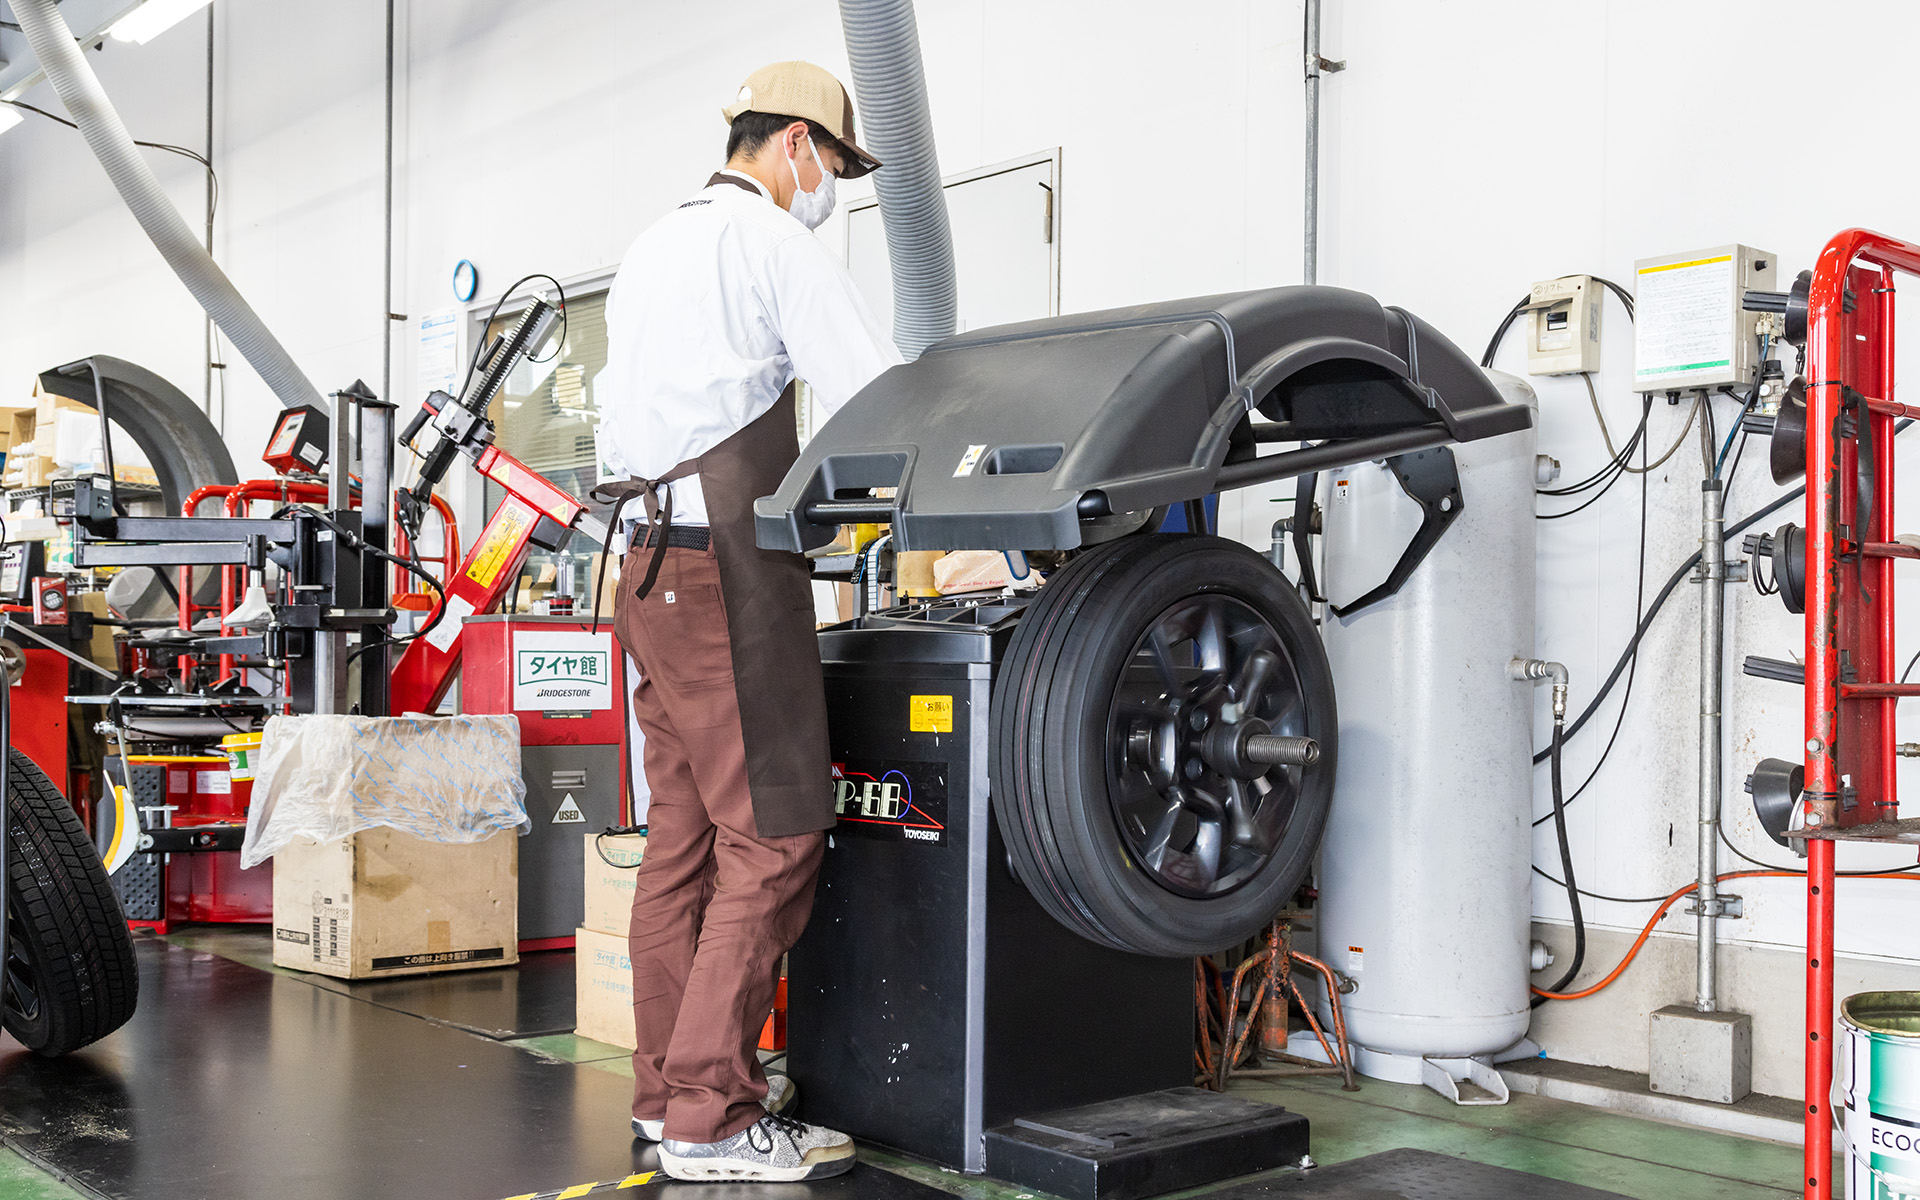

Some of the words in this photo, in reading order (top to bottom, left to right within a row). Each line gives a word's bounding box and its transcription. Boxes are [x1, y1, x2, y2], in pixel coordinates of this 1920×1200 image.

[530, 656, 597, 676] タイヤ館
[536, 688, 592, 698] BRIDGESTONE
[558, 810, 579, 821] USED
[904, 829, 940, 841] TOYOSEIKI
